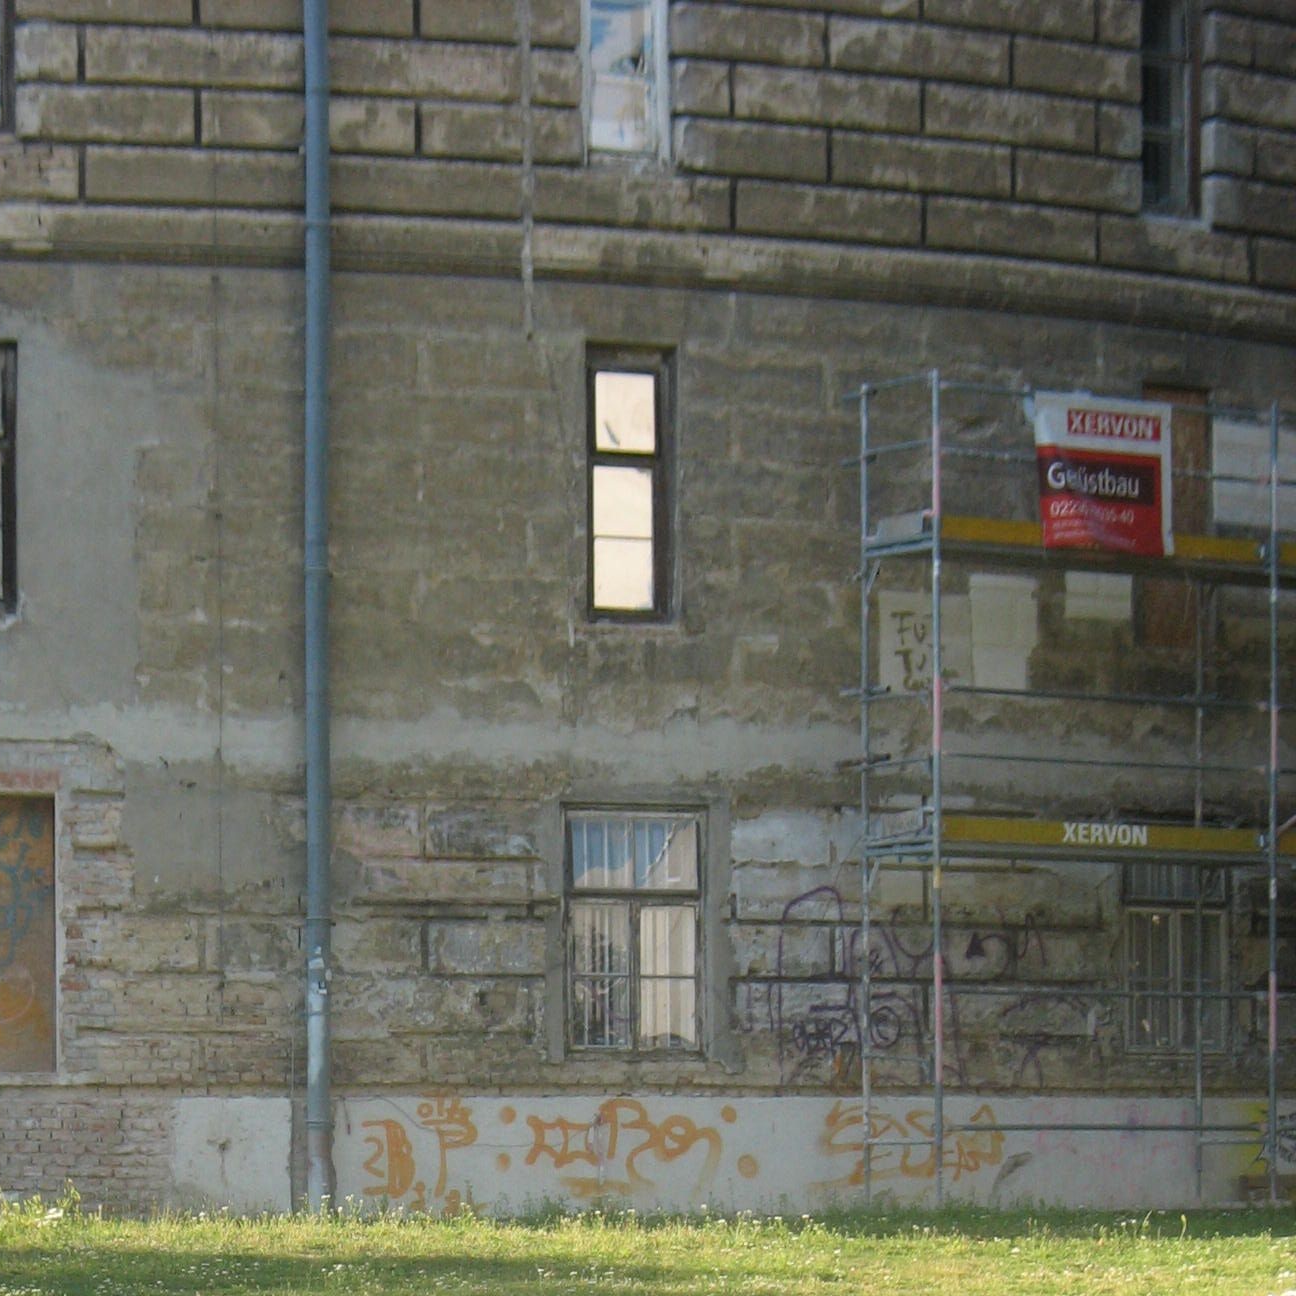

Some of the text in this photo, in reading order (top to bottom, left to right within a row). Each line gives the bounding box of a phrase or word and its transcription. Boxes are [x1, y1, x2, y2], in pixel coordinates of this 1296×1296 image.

[1069, 411, 1154, 439] XERVON
[1047, 462, 1140, 498] Geüstbau
[1063, 822, 1148, 846] XERVON
